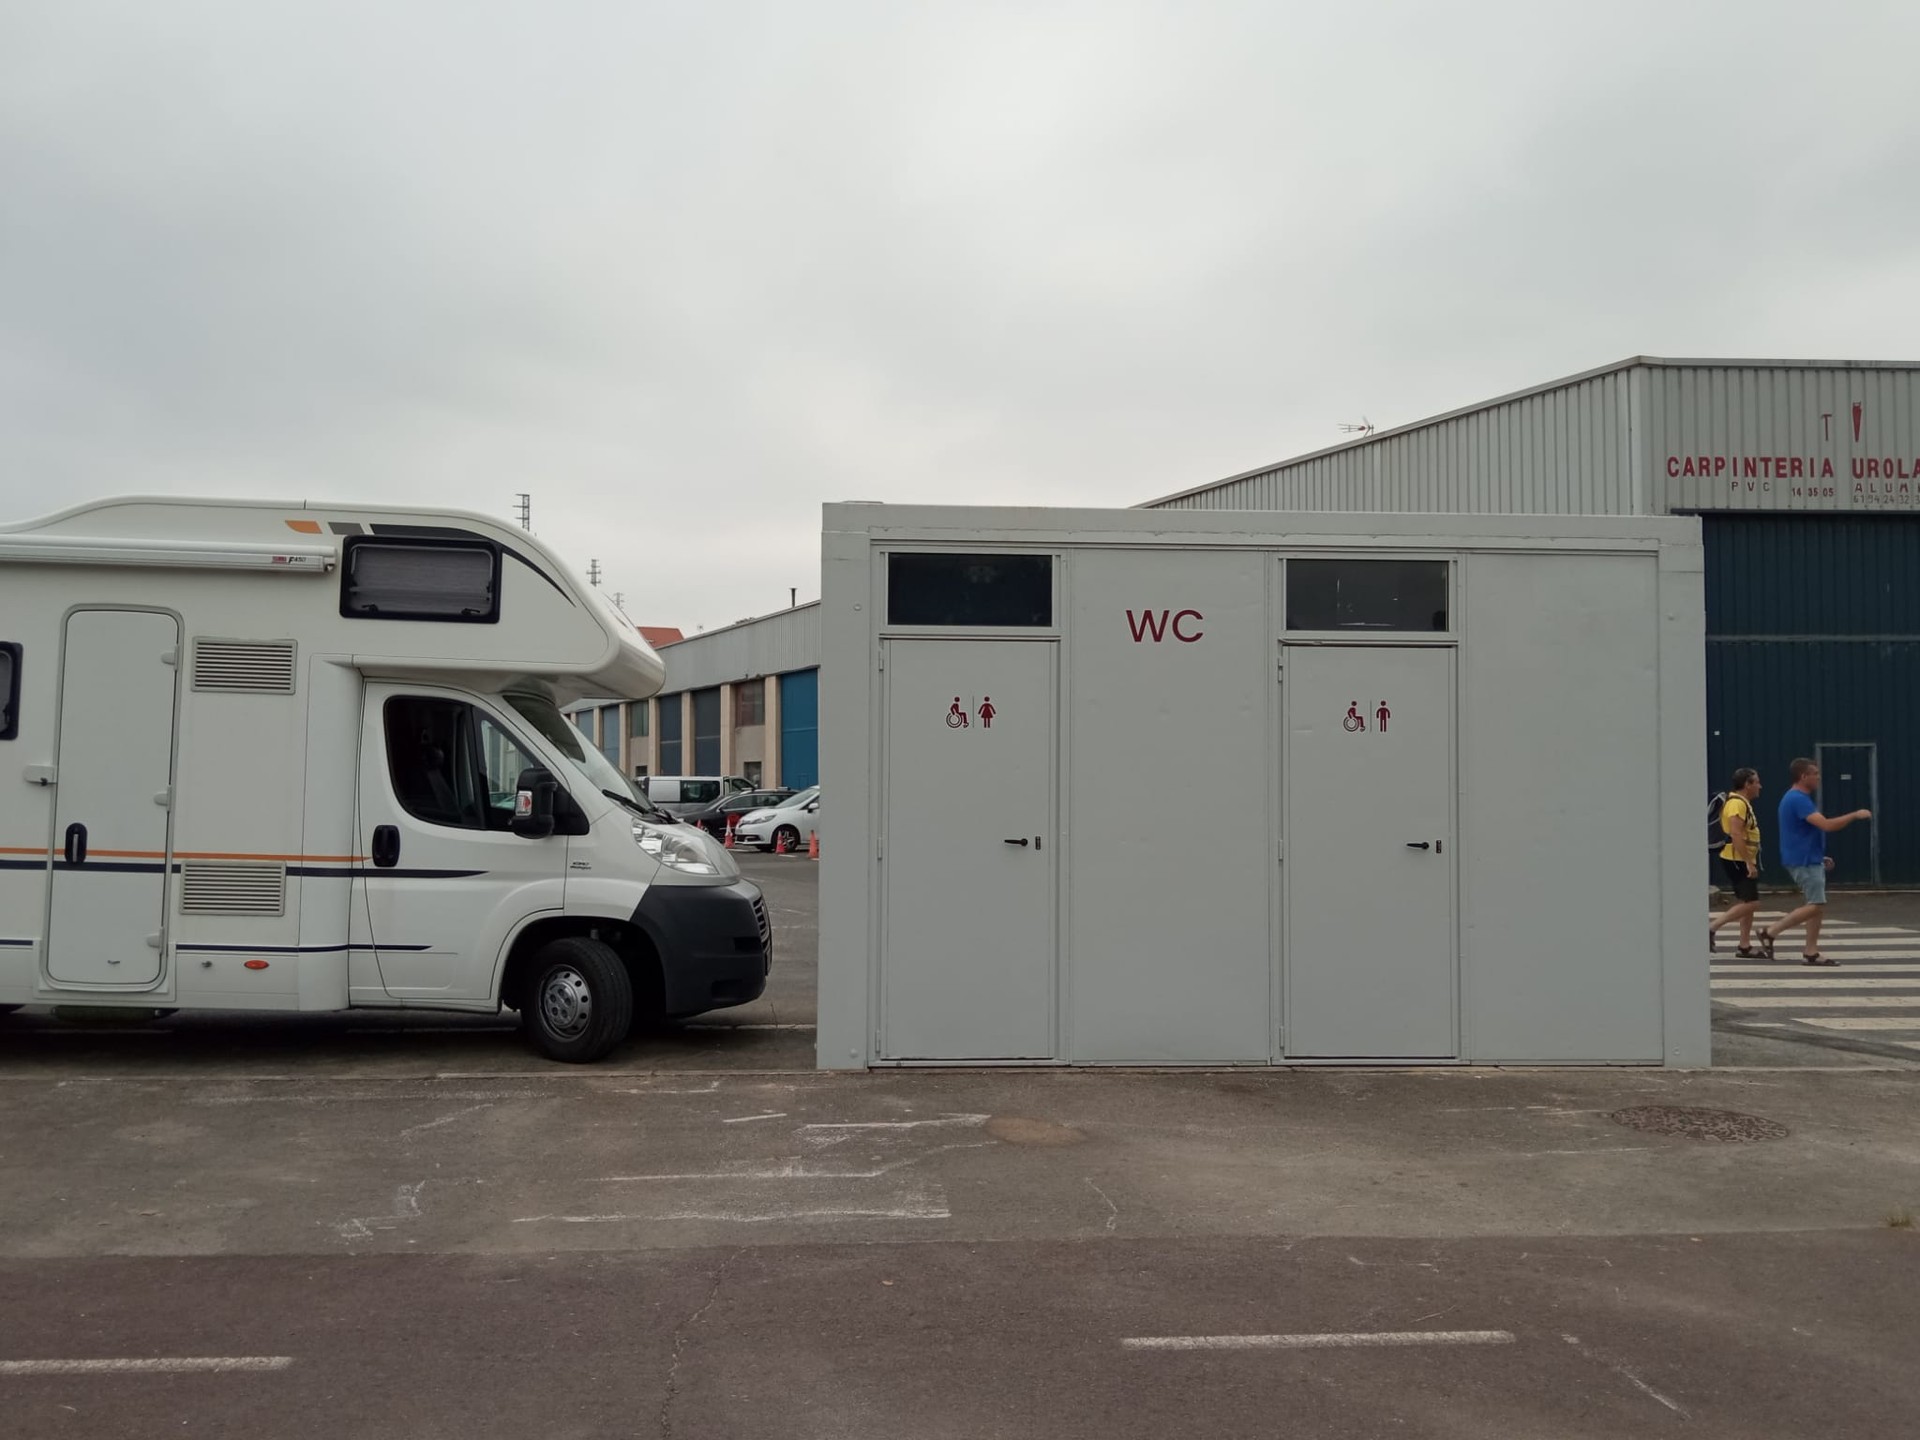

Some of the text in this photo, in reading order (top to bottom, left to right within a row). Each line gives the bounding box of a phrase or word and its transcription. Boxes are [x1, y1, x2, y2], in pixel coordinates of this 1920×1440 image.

[1667, 456, 1920, 479] CARPINTERIA UROLA
[1126, 609, 1204, 643] WC
